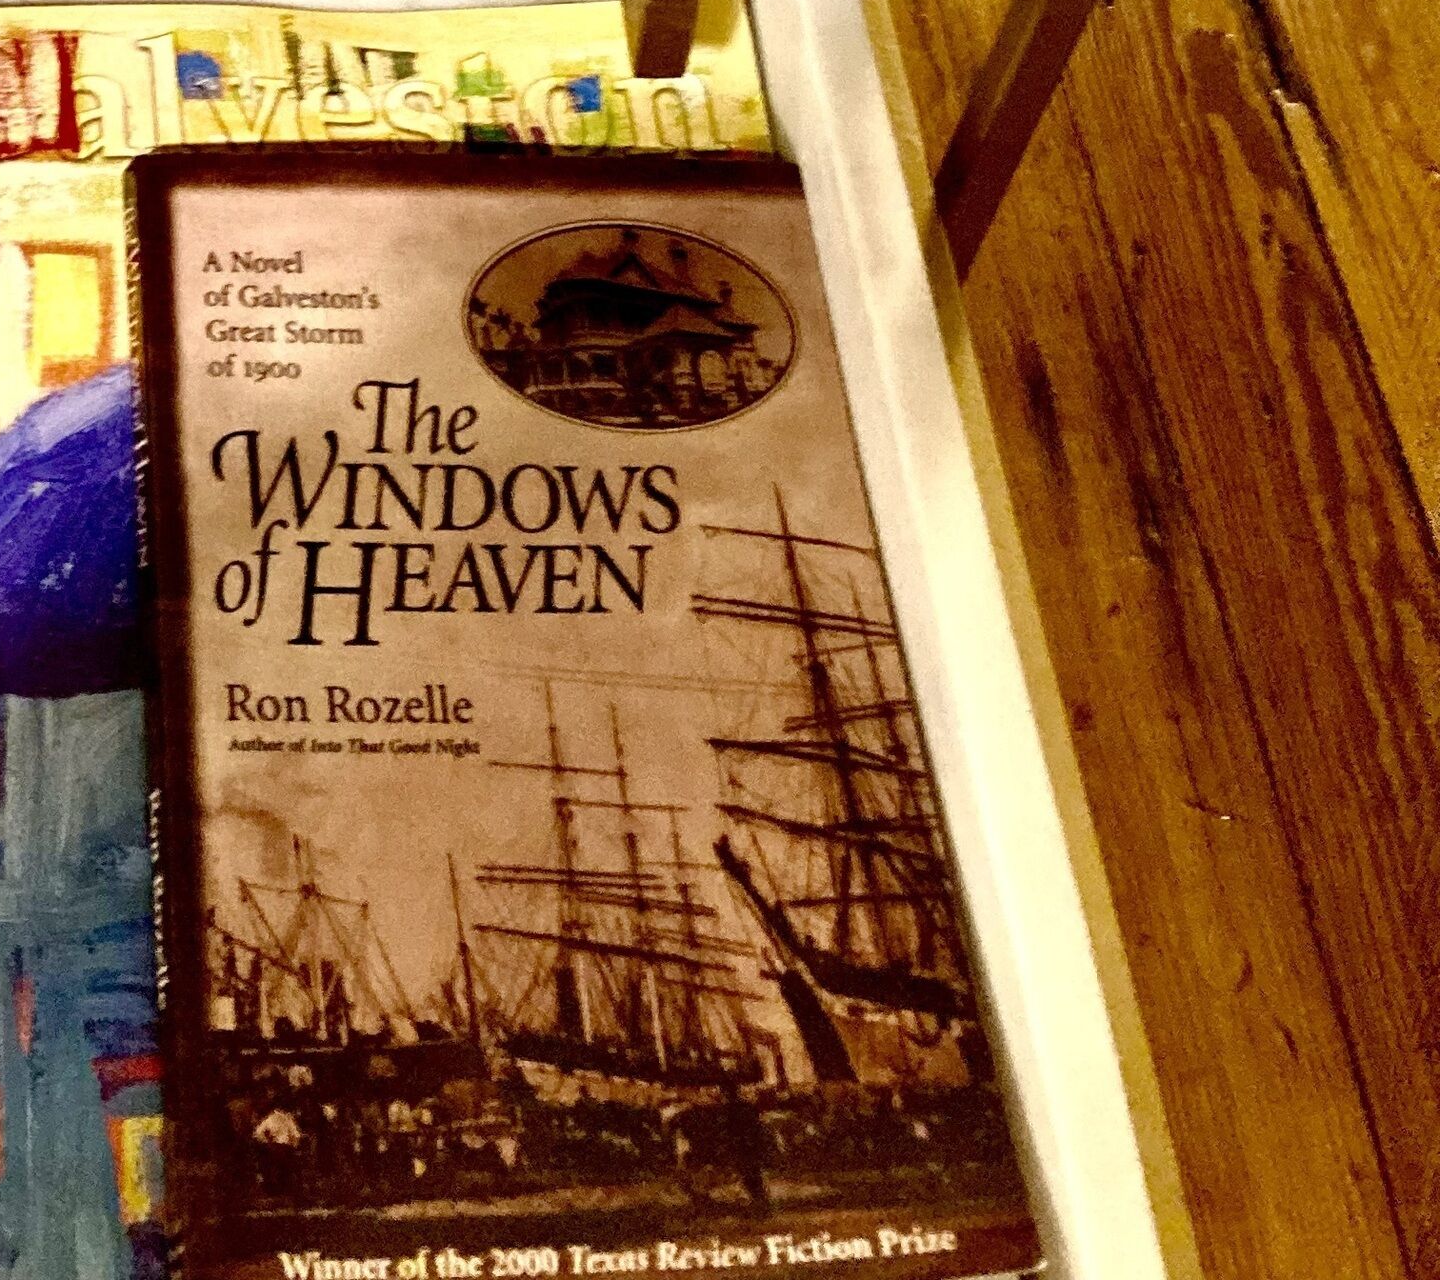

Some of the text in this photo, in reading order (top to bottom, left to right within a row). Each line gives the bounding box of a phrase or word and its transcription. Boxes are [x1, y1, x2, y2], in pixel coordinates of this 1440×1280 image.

[202, 250, 305, 274] A Novel
[202, 282, 381, 310] of Galveston's
[205, 318, 365, 345] Great Storm
[207, 352, 303, 383] of 1900
[352, 377, 481, 456] The
[211, 428, 682, 536] WINDOWS
[213, 520, 655, 647] of HEAVEN
[225, 683, 474, 726] Ron Rozelle
[276, 1224, 959, 1280] Winner of the 2000 Texas Review Fiction Prize
